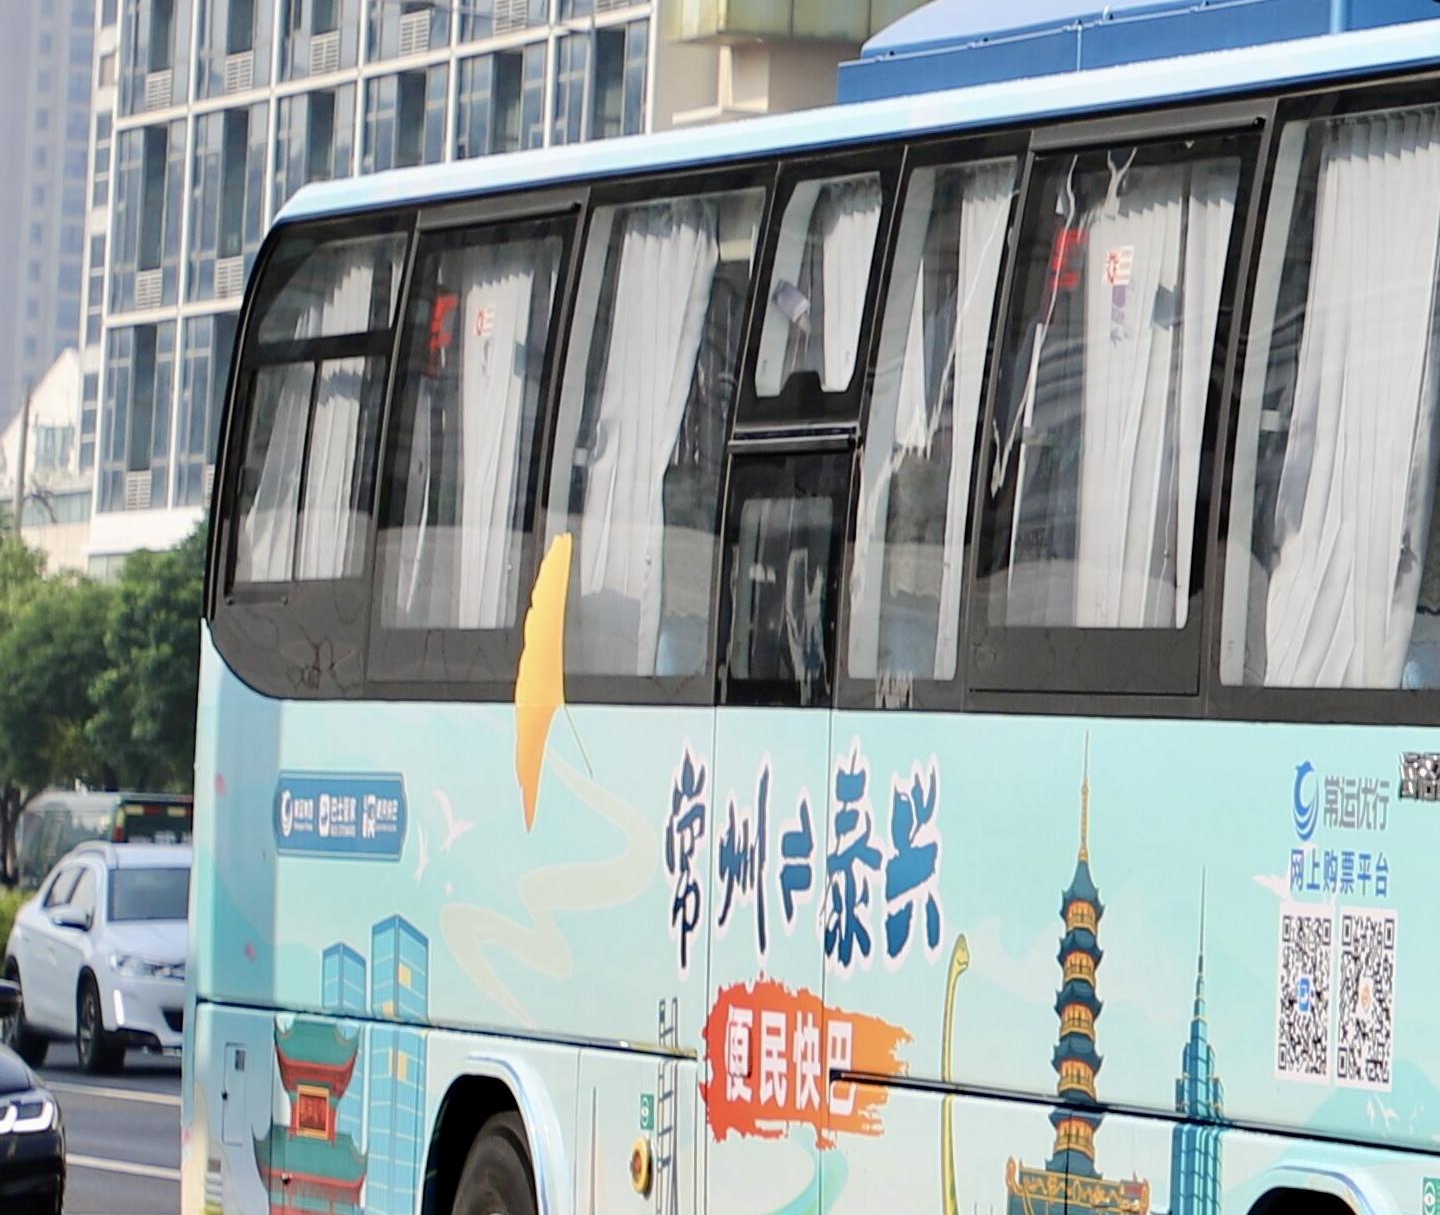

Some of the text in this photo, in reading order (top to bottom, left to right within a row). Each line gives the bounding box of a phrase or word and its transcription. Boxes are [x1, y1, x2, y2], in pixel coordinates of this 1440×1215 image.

[1322, 774, 1391, 832] 常运优行
[825, 747, 941, 969] 泰兴
[1289, 847, 1390, 899] 网上购票平台
[724, 1001, 857, 1117] 便民快巴
